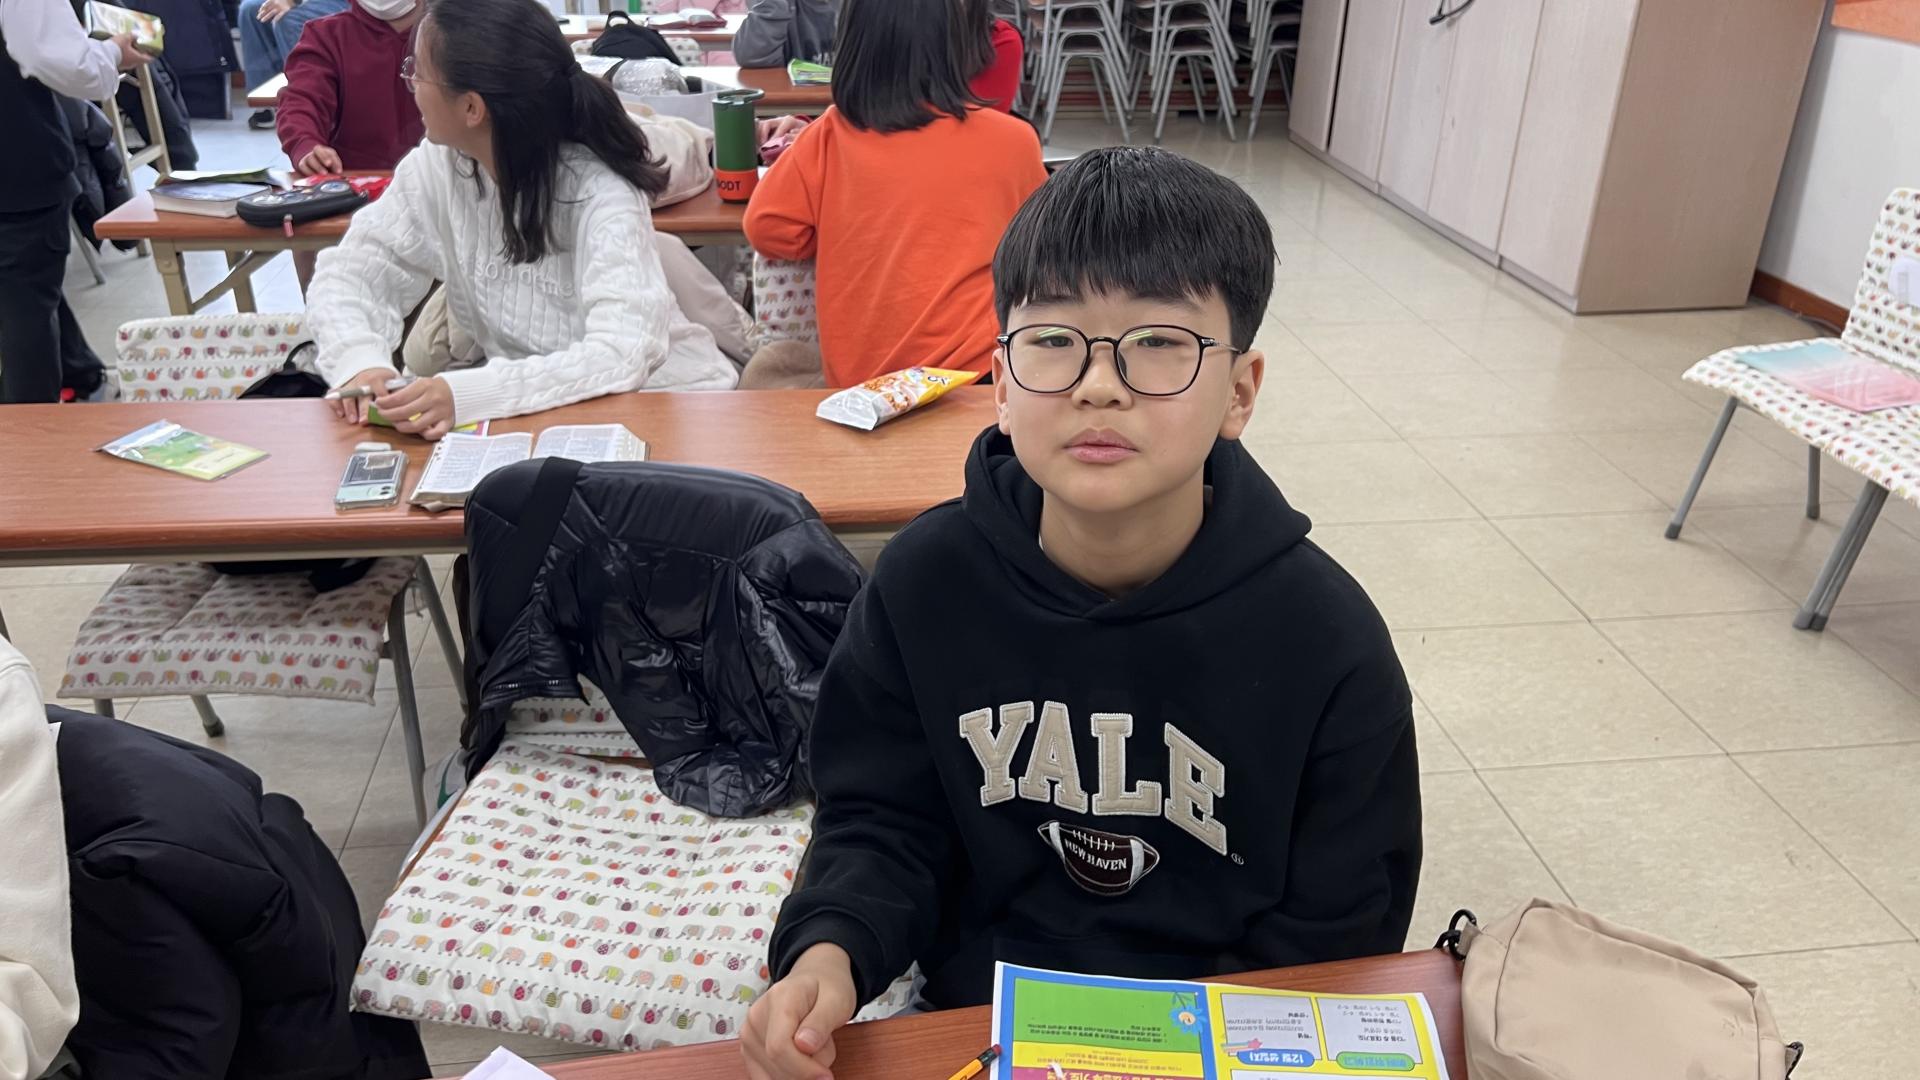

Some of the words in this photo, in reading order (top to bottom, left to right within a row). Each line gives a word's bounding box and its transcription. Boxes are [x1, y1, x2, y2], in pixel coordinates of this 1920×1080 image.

[958, 699, 1228, 857] YALE
[1064, 838, 1086, 860] NEW
[1086, 852, 1127, 871] HAVEN
[1282, 1053, 1304, 1064] 12월
